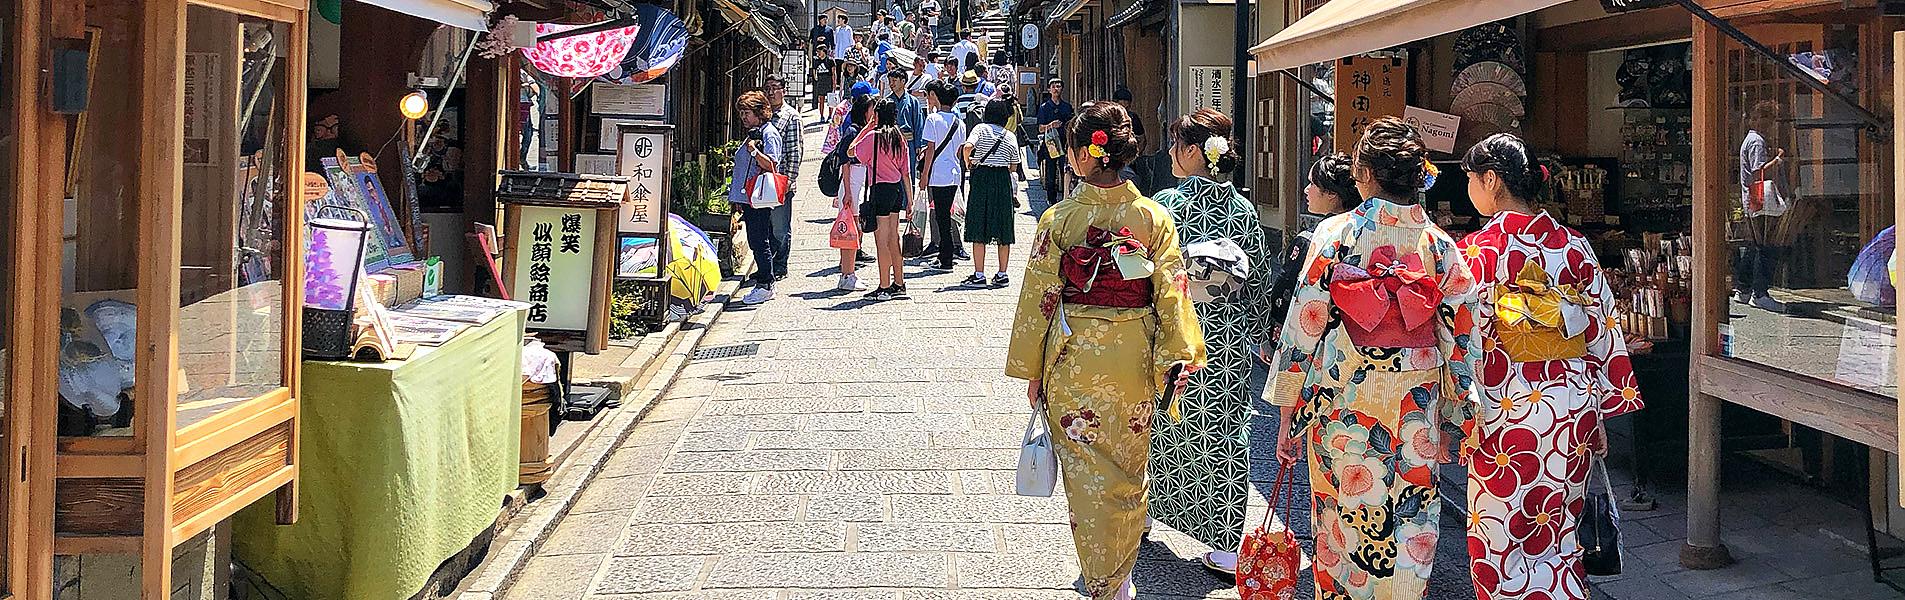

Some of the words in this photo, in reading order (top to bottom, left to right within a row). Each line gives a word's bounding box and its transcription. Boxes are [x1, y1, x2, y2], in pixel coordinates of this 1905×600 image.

[1421, 125, 1455, 139] Nagomi
[630, 162, 653, 223] 和傘屋
[560, 213, 581, 254] 爆笑
[527, 222, 553, 323] 似顔絵商店
